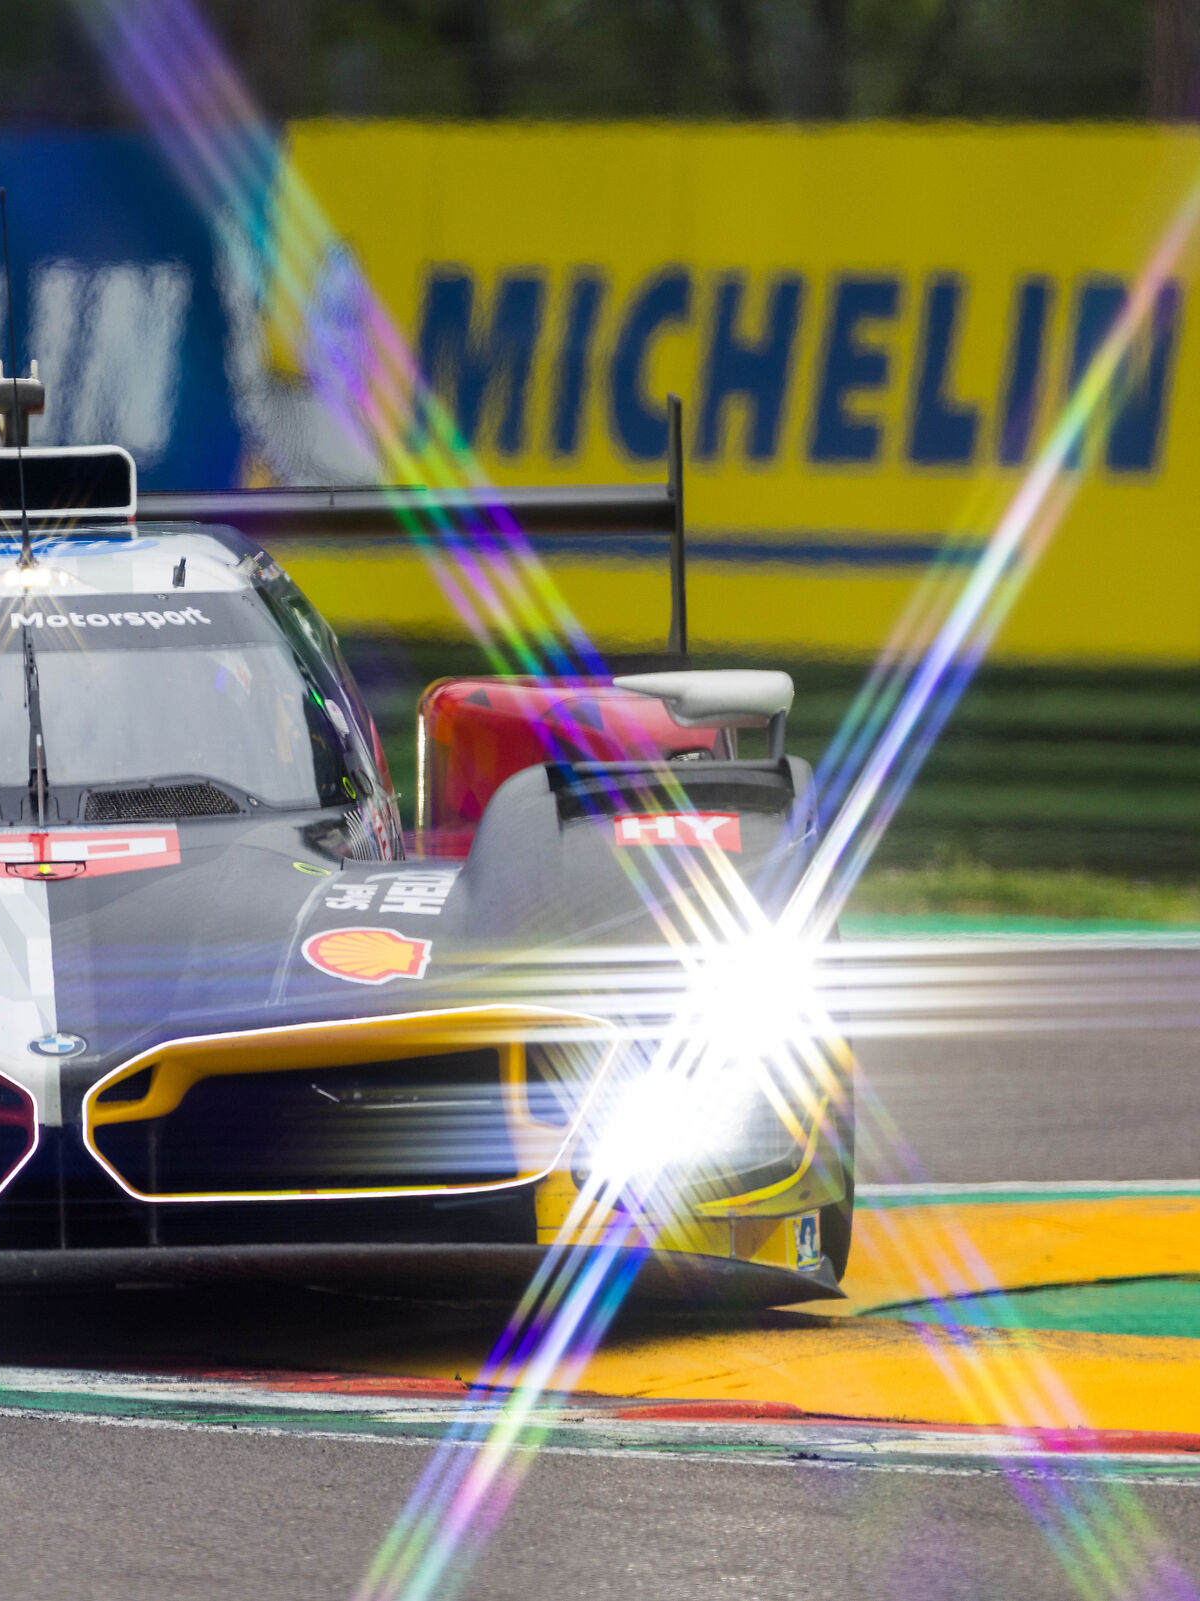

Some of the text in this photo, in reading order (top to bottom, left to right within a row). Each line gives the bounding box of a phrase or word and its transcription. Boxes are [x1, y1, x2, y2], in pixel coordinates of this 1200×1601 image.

[412, 270, 1180, 468] MICHELIN
[11, 607, 211, 630] Motorsport
[622, 815, 731, 840] HY
